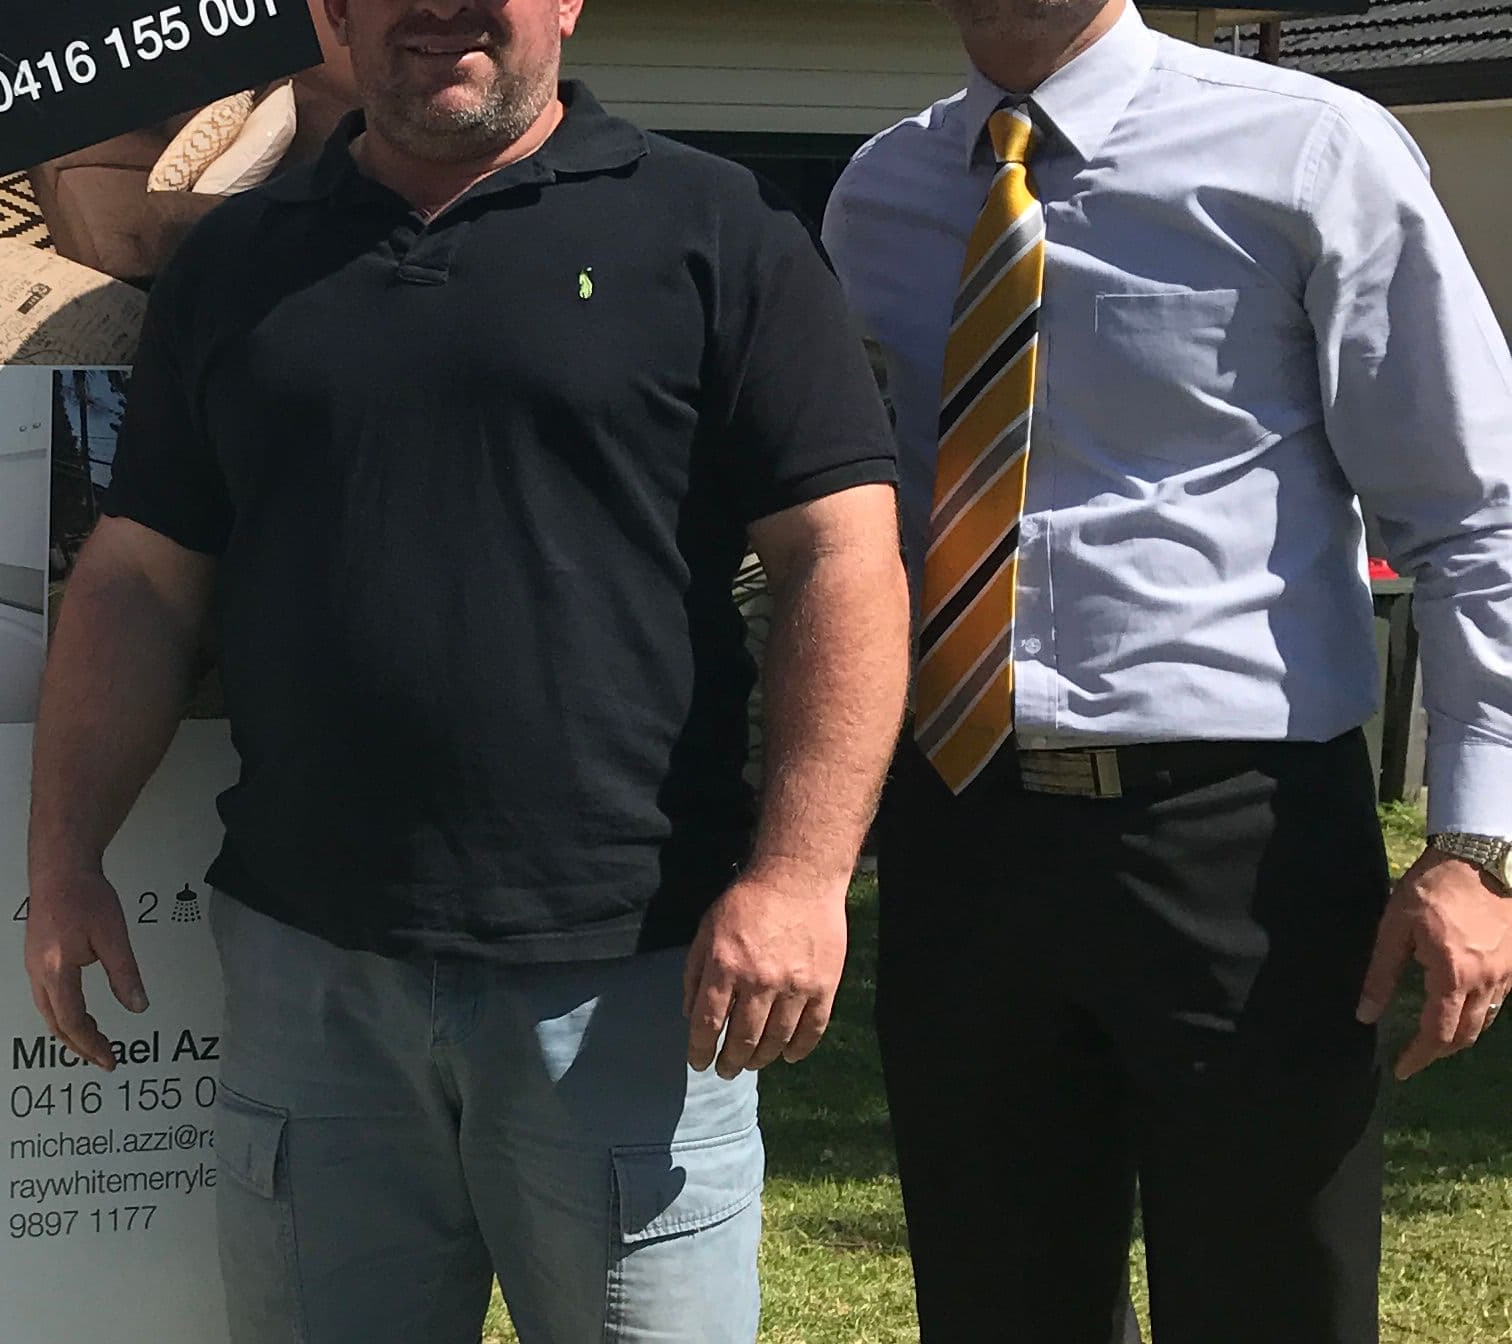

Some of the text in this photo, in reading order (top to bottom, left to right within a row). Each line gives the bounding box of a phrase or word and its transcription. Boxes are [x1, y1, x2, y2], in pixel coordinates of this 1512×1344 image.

[104, 7, 189, 70] 155
[138, 892, 158, 924] 2
[13, 1031, 159, 1070] Micael
[11, 1081, 102, 1117] 0416
[118, 1078, 181, 1111] 155
[9, 1206, 157, 1238] 9897 1177
